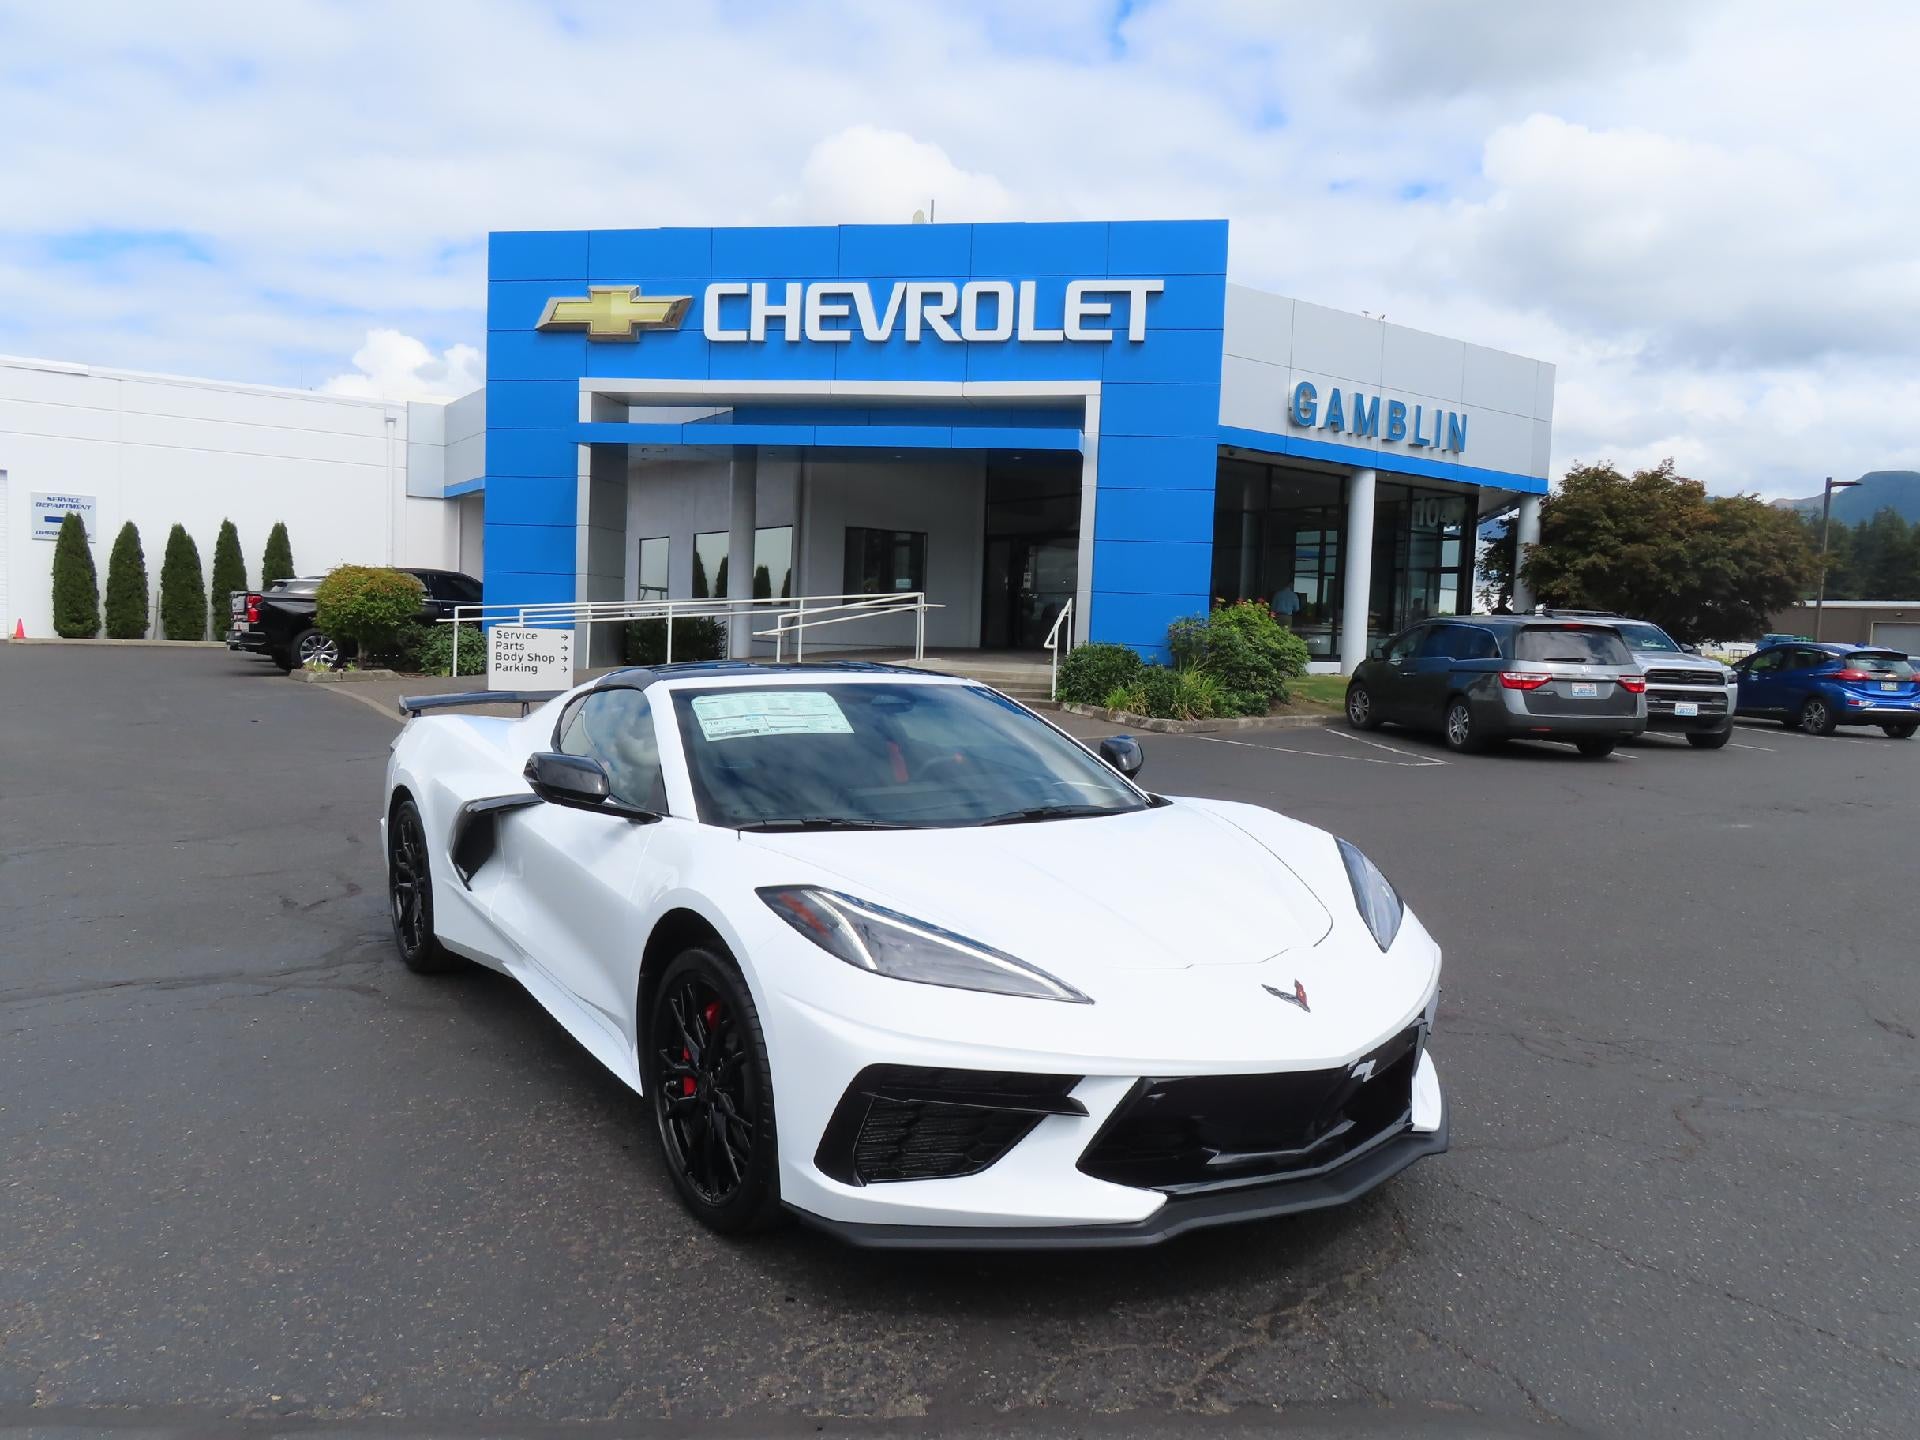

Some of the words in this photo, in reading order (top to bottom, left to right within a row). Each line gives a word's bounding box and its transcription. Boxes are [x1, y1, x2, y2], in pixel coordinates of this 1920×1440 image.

[702, 279, 1165, 344] CHEVROLET
[1288, 380, 1468, 453] GAMBLIN
[46, 496, 82, 504] SERVICE
[35, 502, 92, 510] DEPARTMENT
[496, 630, 538, 640] Service
[495, 641, 525, 651] Parts
[495, 651, 524, 663] Body
[527, 652, 555, 664] Shop
[495, 663, 538, 675] Parking
